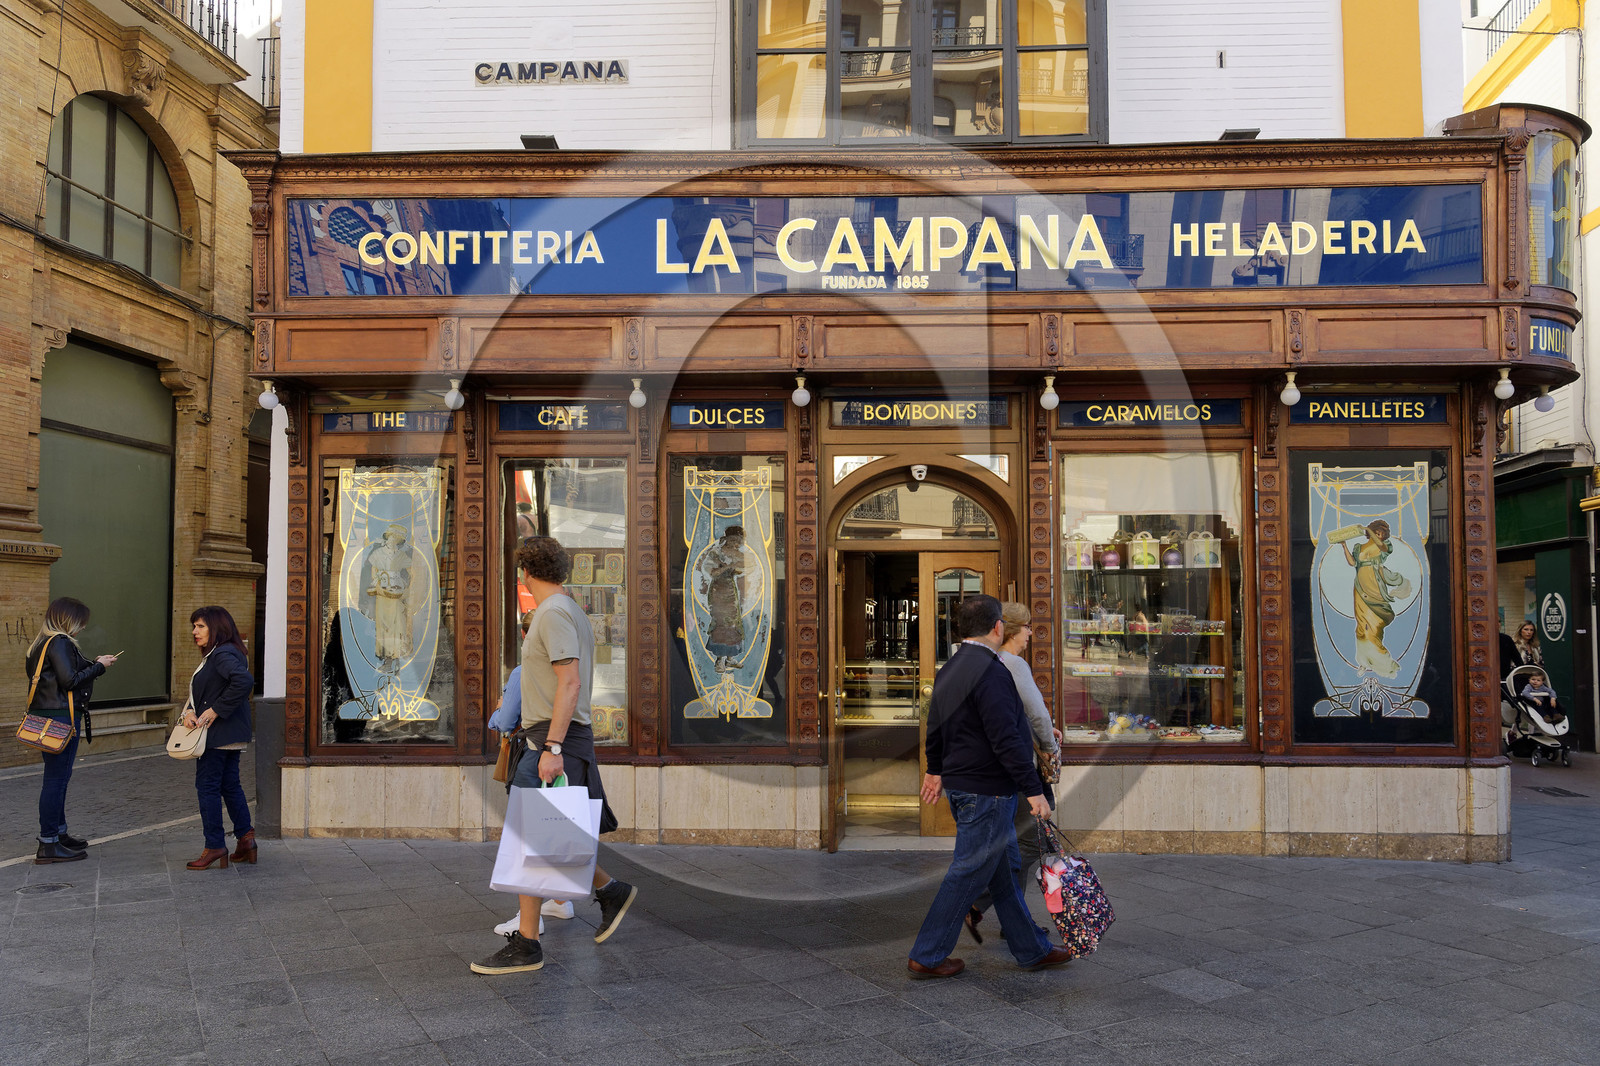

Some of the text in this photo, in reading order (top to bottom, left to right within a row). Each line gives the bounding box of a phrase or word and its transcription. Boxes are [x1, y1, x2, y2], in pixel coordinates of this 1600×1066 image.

[1217, 51, 1225, 69] 1
[475, 60, 627, 84] CAMPANA
[655, 213, 1114, 275] LA CAMPANA
[1172, 218, 1427, 258] HELADERIA
[357, 229, 606, 267] CONFITERIA
[821, 275, 929, 290] FUNDADA 1885
[1530, 325, 1570, 356] FUNDA
[372, 411, 406, 429] THE
[536, 405, 589, 426] CAFÉ
[688, 407, 766, 425] DULCES
[862, 402, 978, 421] BOMBONES
[1085, 404, 1212, 422] CARAMELOS
[1308, 402, 1426, 420] PANELLETES
[1546, 615, 1561, 623] BODY
[1549, 607, 1558, 615] THE
